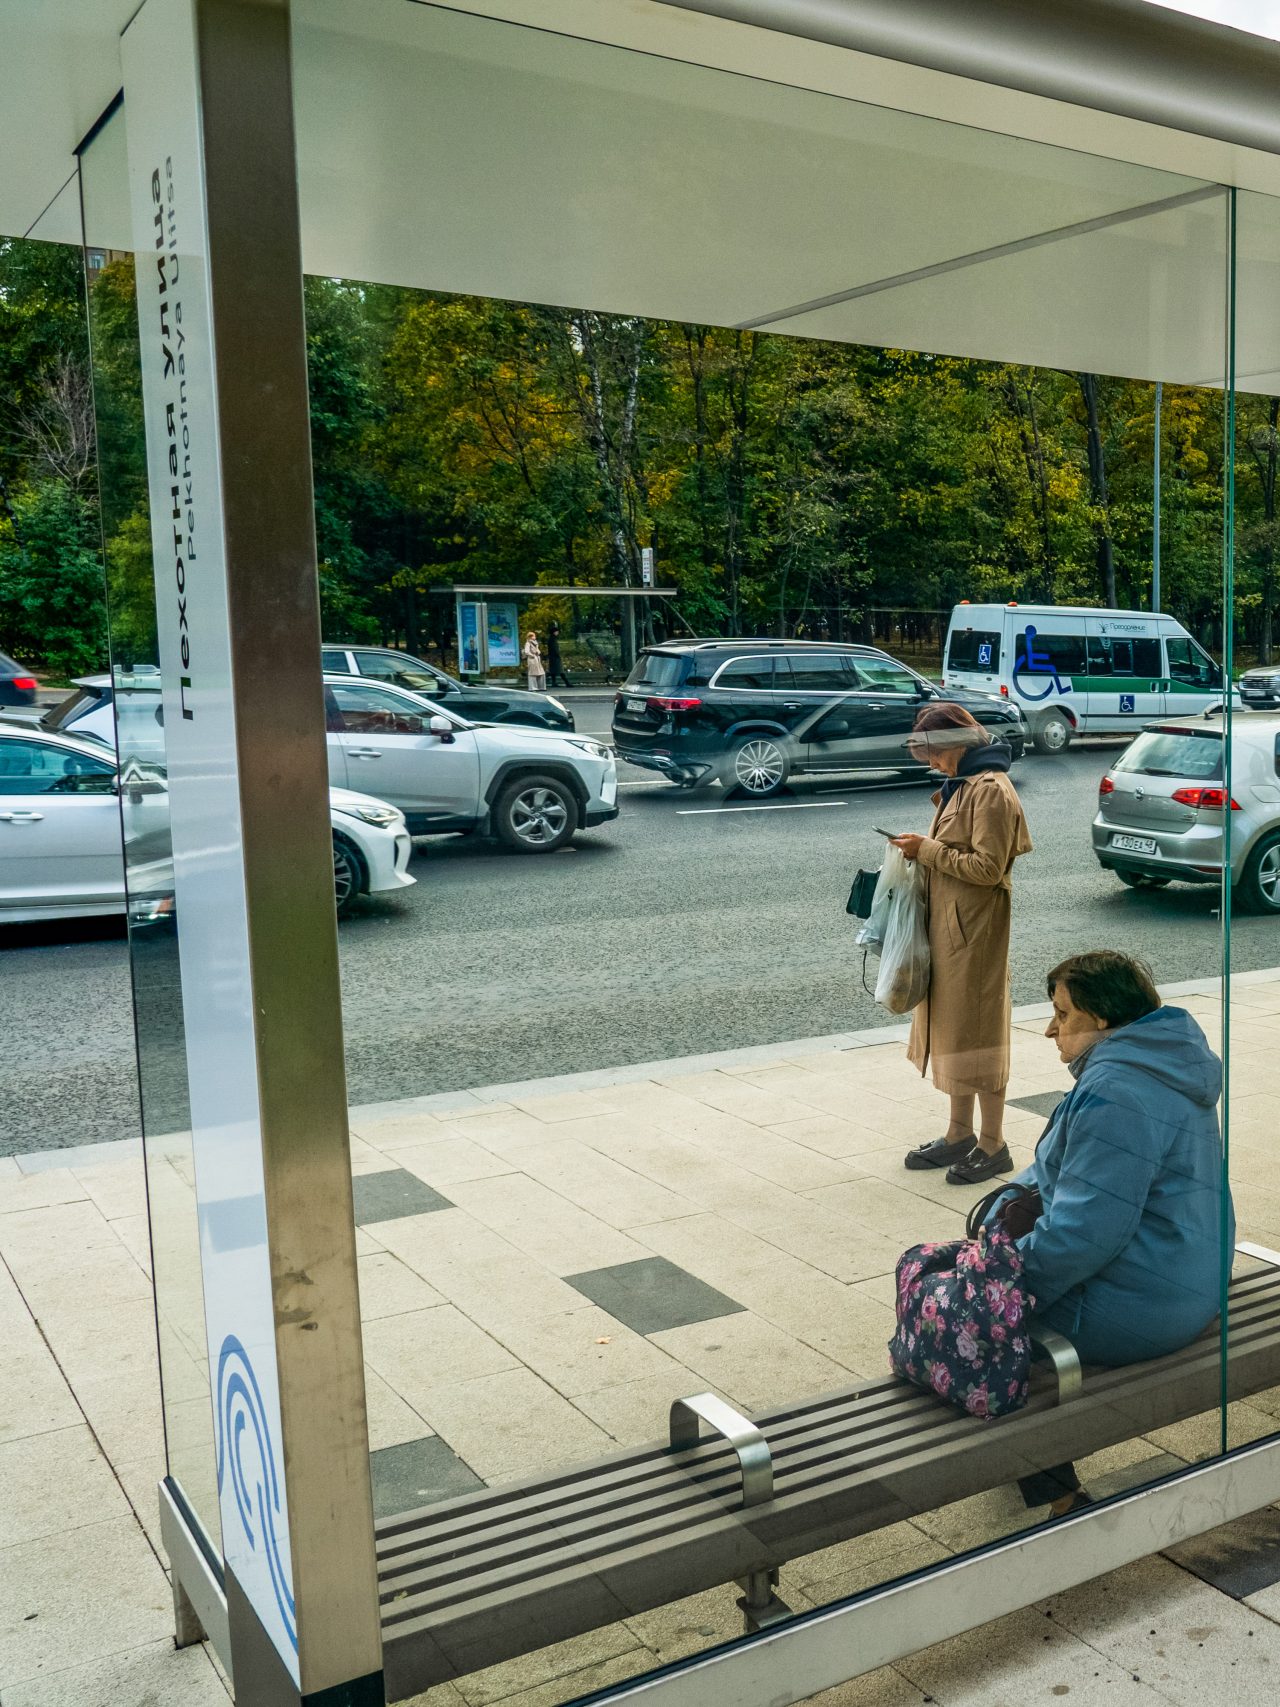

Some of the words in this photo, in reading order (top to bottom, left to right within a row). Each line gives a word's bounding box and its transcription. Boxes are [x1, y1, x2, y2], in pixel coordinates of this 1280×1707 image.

[151, 167, 176, 380] улица
[164, 155, 181, 286] Ulitsa
[174, 302, 197, 561] Pekhotnaya
[165, 402, 194, 721] Пехотная
